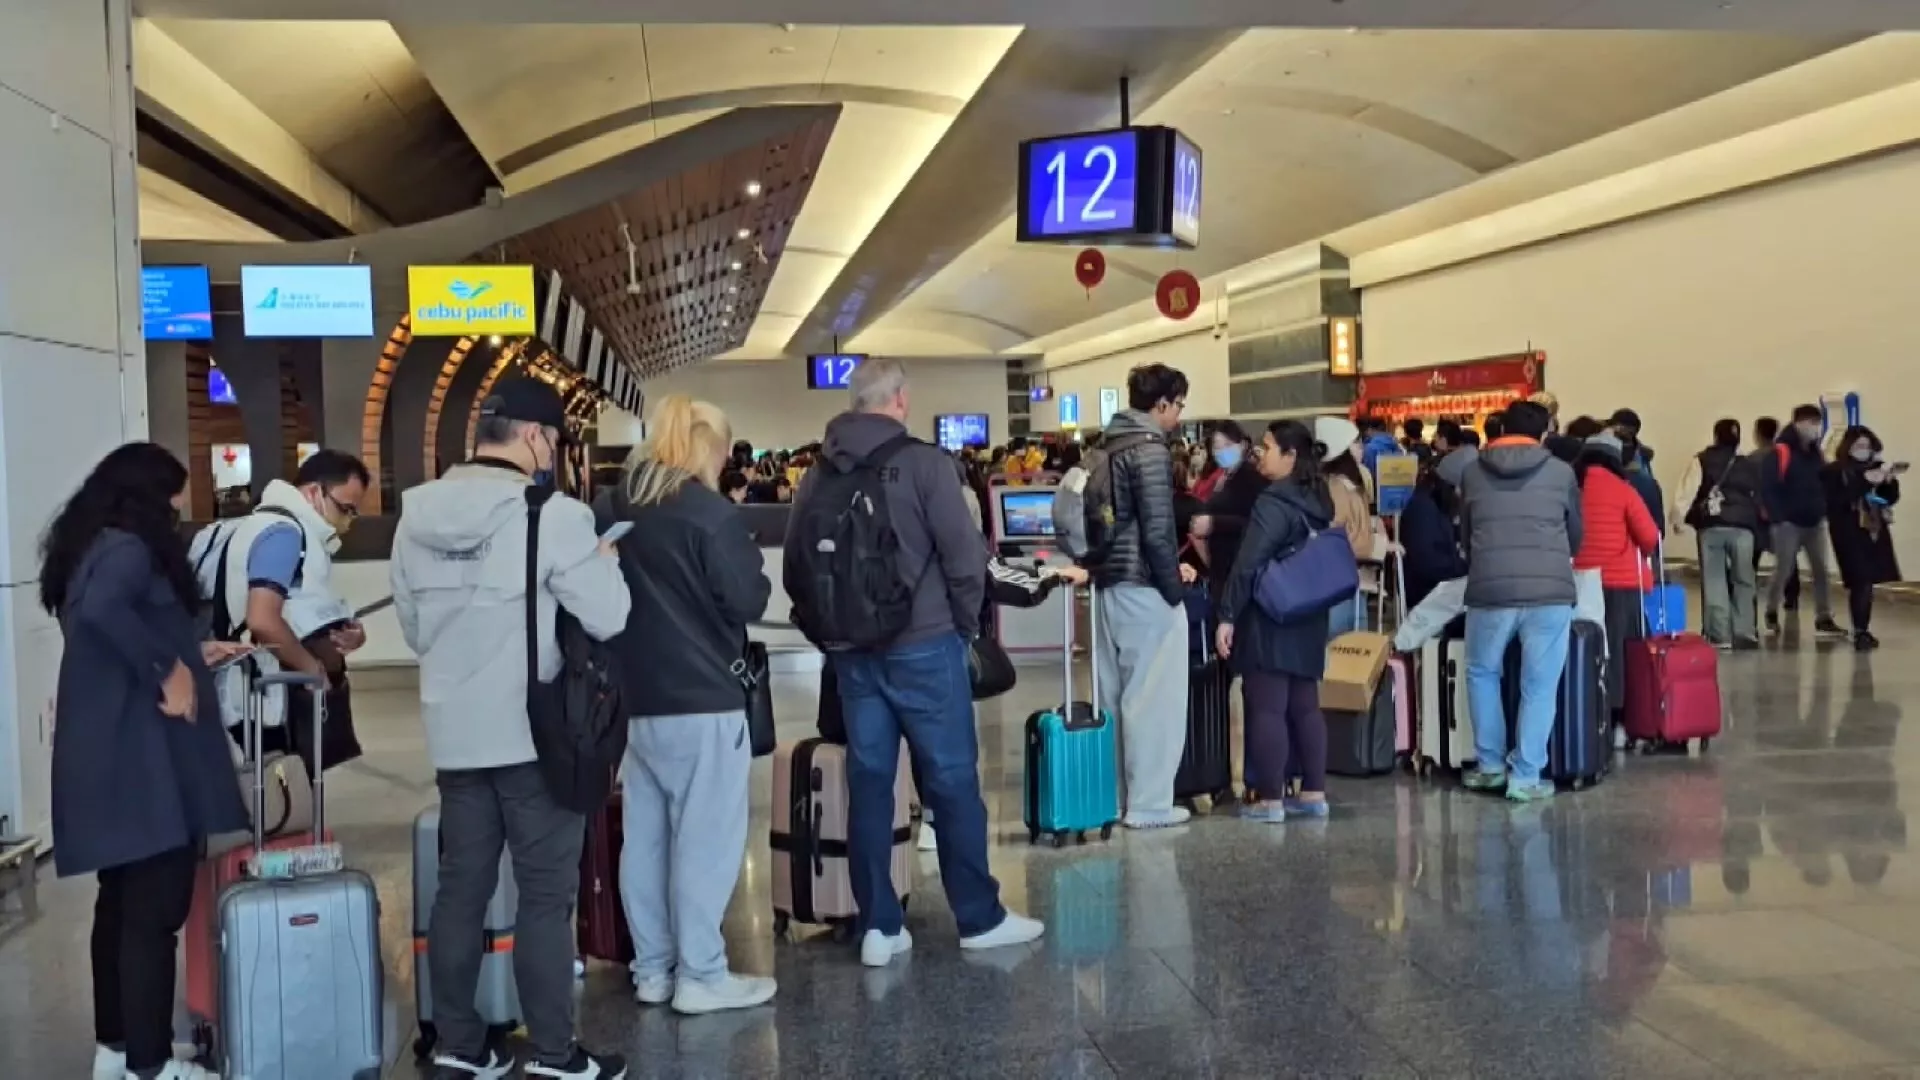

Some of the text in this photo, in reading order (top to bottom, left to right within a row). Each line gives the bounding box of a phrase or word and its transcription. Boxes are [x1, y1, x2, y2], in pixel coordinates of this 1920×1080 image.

[1046, 144, 1117, 225] 12
[1178, 151, 1198, 230] 12
[418, 301, 527, 324] cebu pacific
[822, 358, 856, 385] 12
